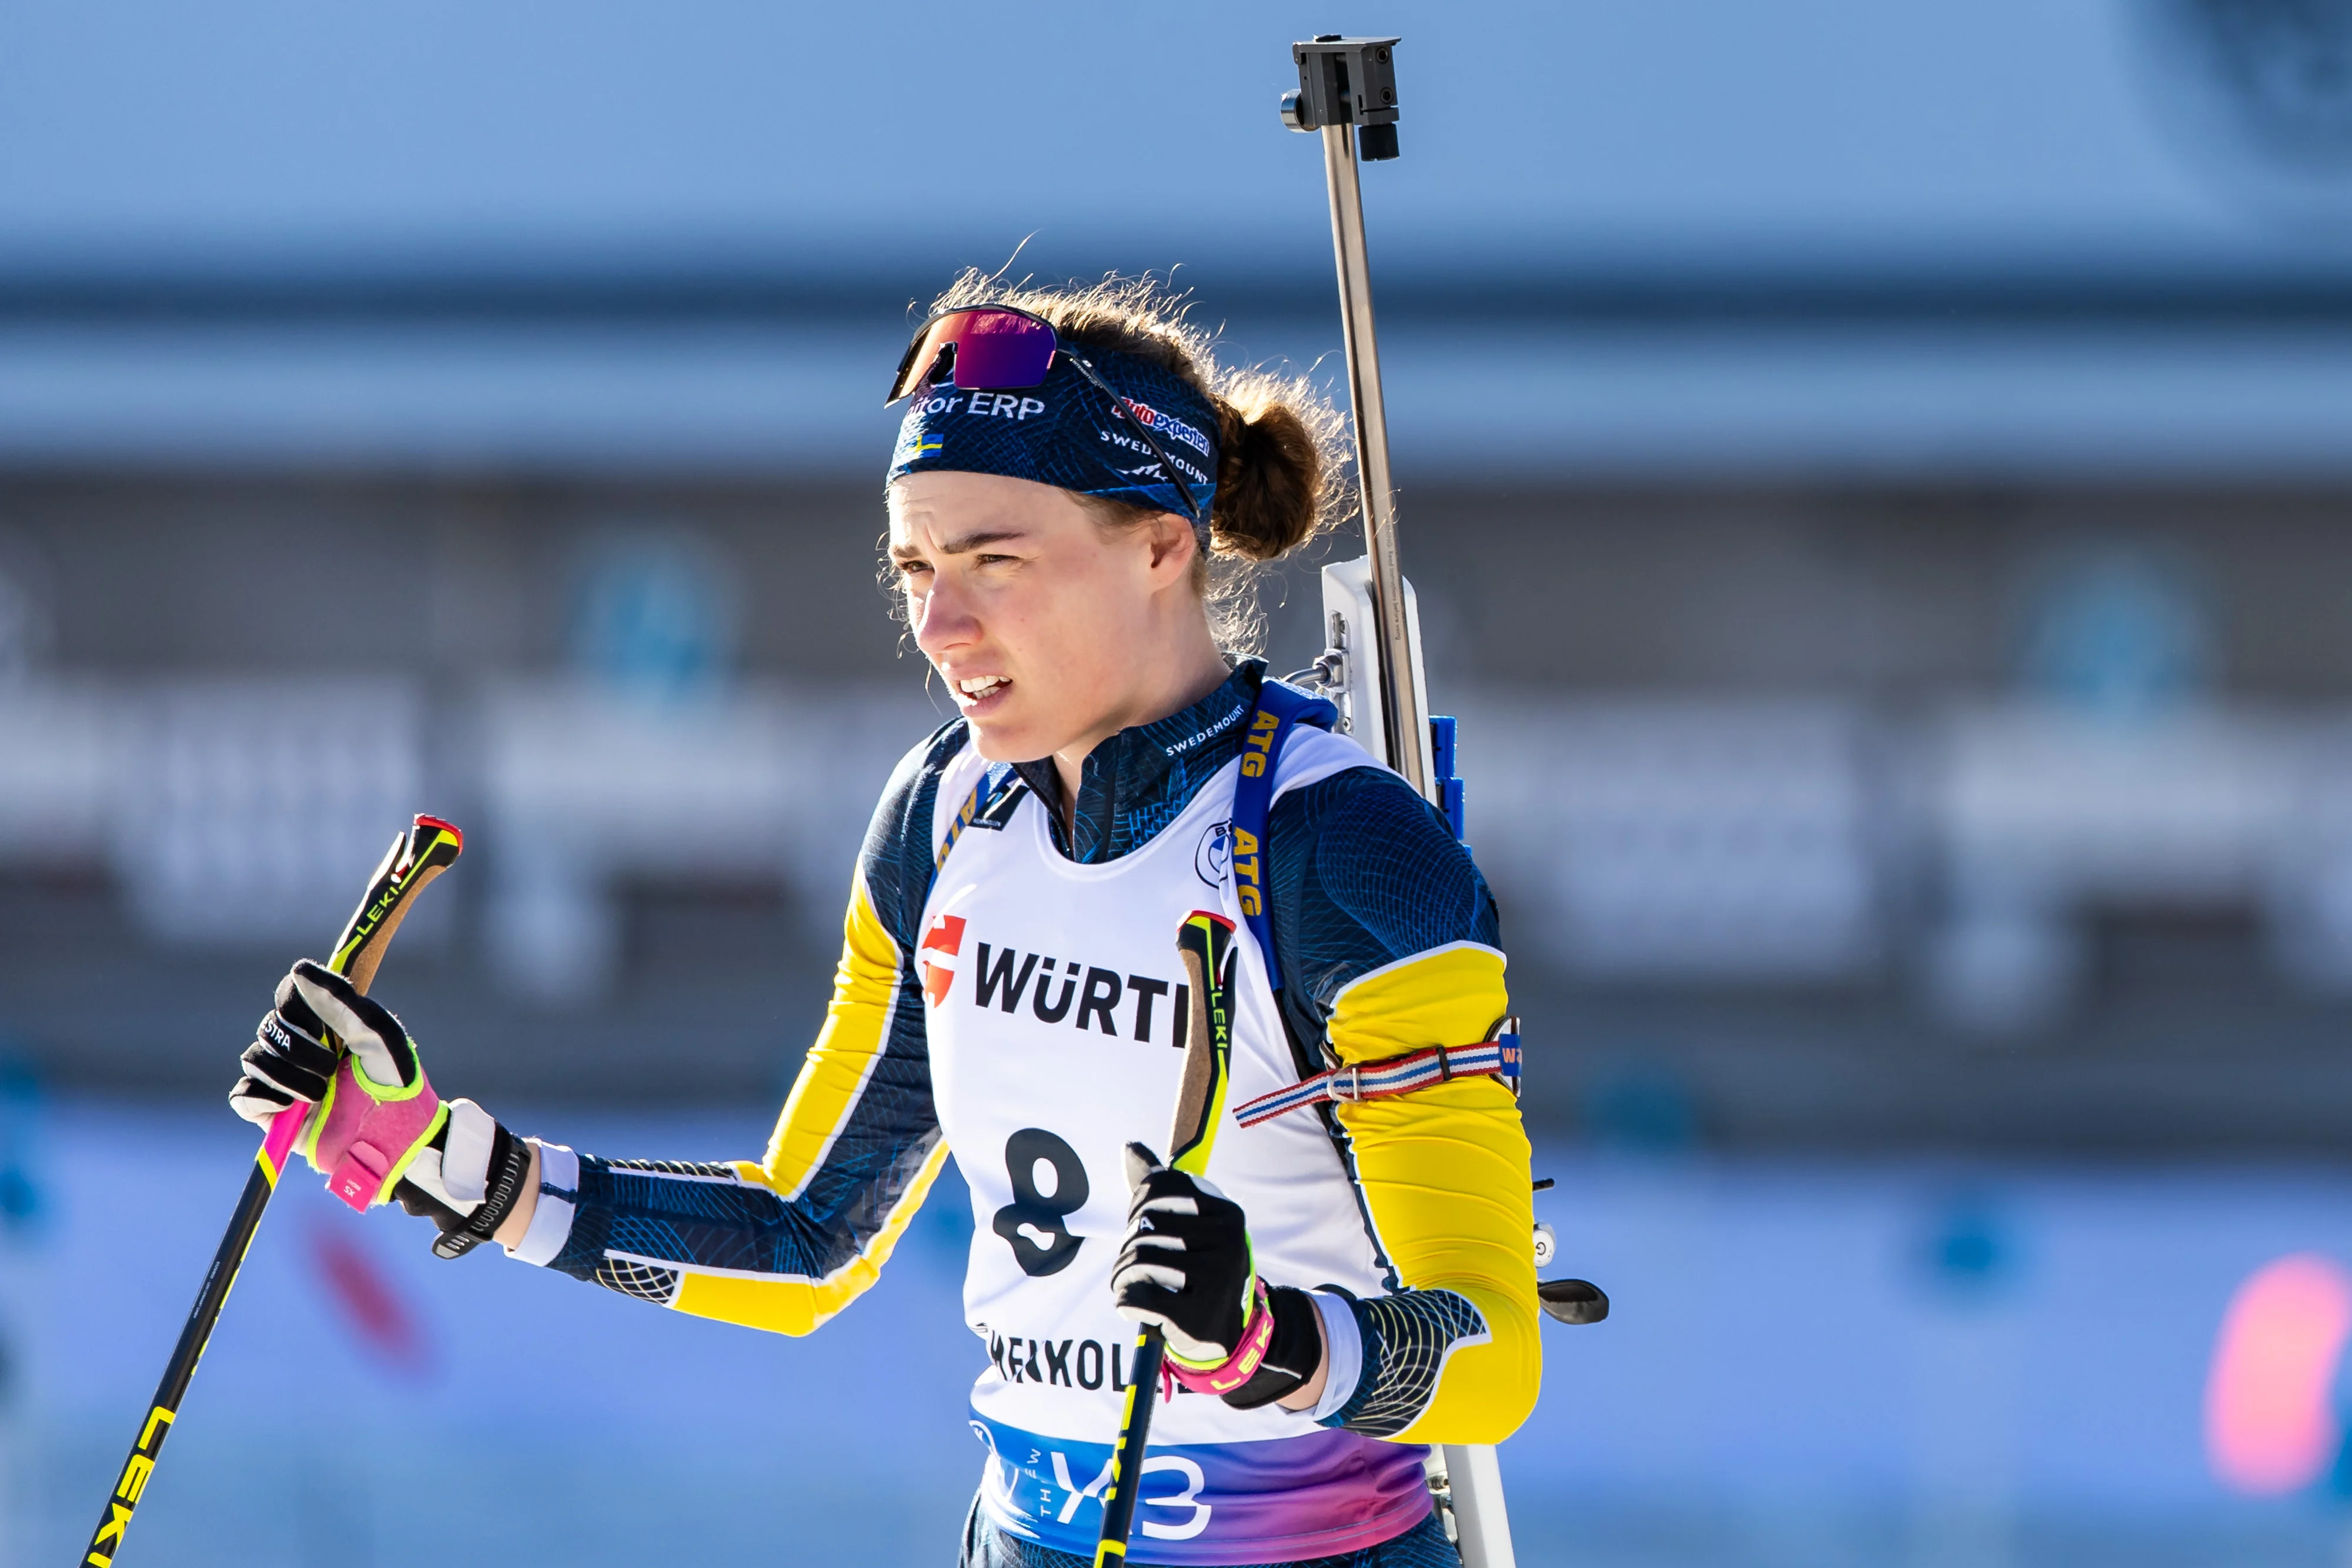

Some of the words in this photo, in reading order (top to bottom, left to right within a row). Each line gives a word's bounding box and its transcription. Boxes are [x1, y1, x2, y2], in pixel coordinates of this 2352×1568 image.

[967, 392, 1045, 420] ERP
[1101, 431, 1208, 486] SWEDMOUNT
[1165, 704, 1244, 757] SWEDEMOUNT
[1241, 709, 1279, 778] ATG
[1234, 826, 1263, 917] ATG
[356, 886, 399, 935] LEKI
[1211, 992, 1228, 1048] LEKI
[343, 1185, 356, 1198] XS
[993, 1128, 1090, 1277] 8
